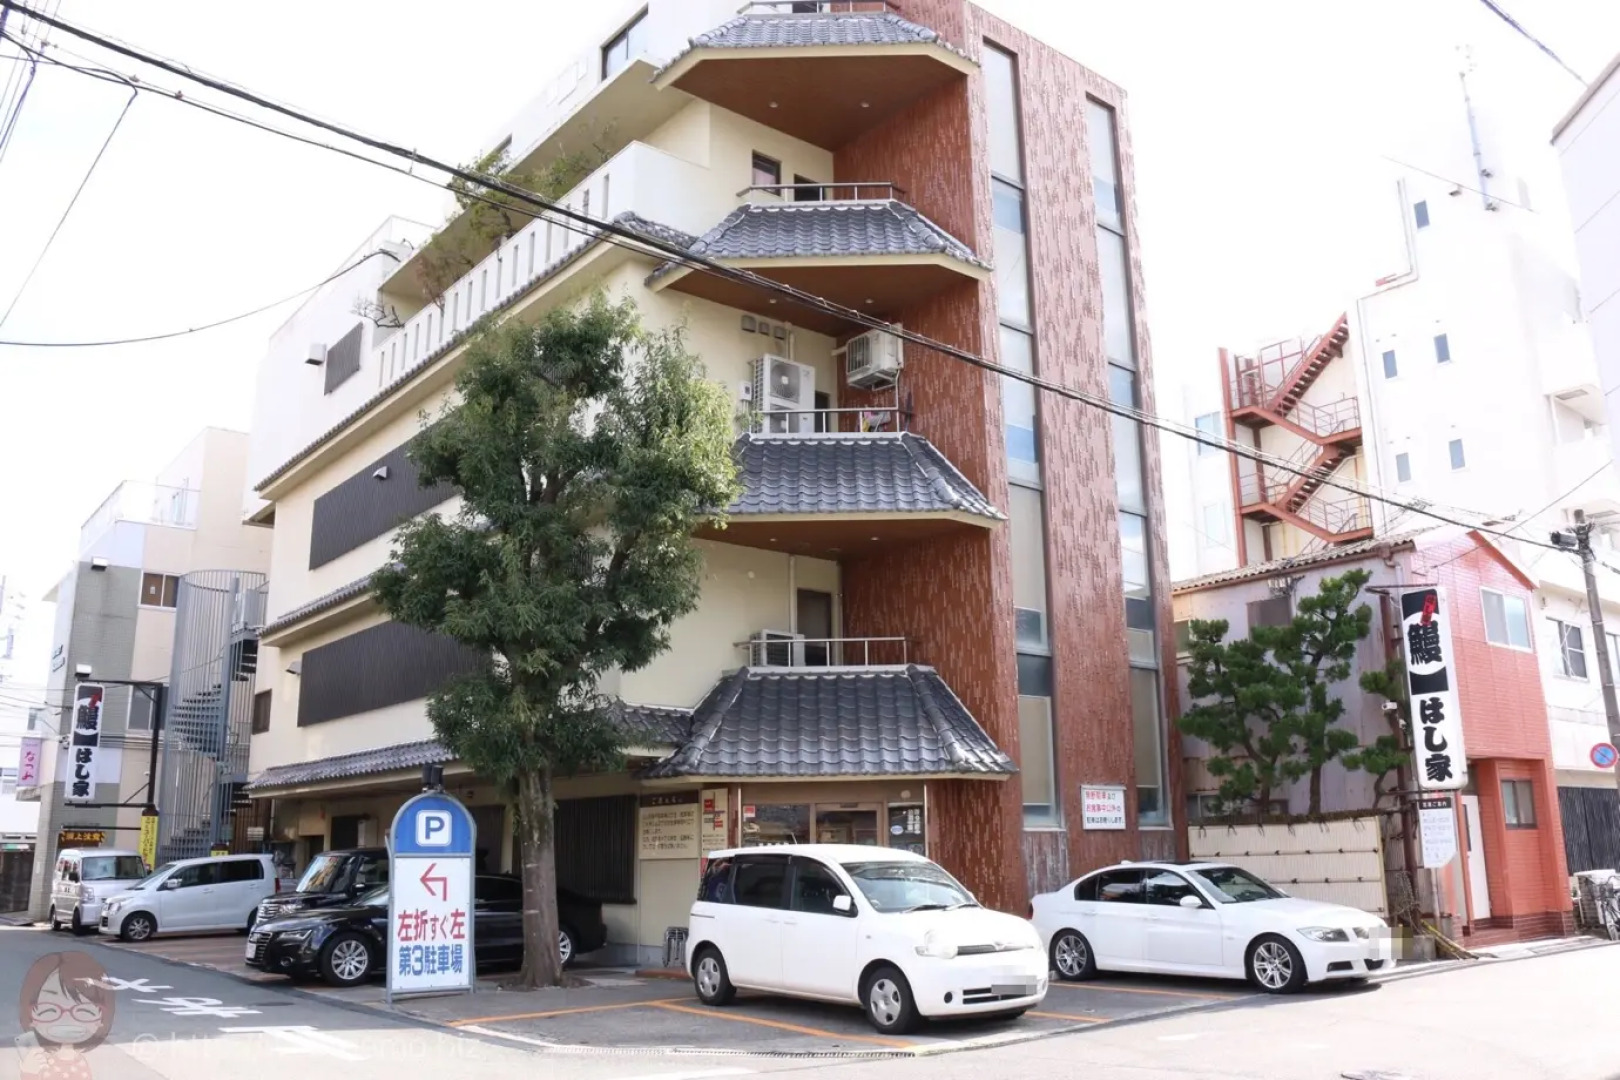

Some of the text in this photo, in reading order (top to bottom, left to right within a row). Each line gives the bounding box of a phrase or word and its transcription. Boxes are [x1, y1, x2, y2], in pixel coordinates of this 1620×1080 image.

[1408, 620, 1442, 666] 鰻
[1419, 696, 1453, 782] はし家
[72, 747, 93, 797] はし家
[425, 816, 445, 840] P
[397, 908, 466, 942] 左折すぐ左
[399, 943, 463, 977] 第3駐車場
